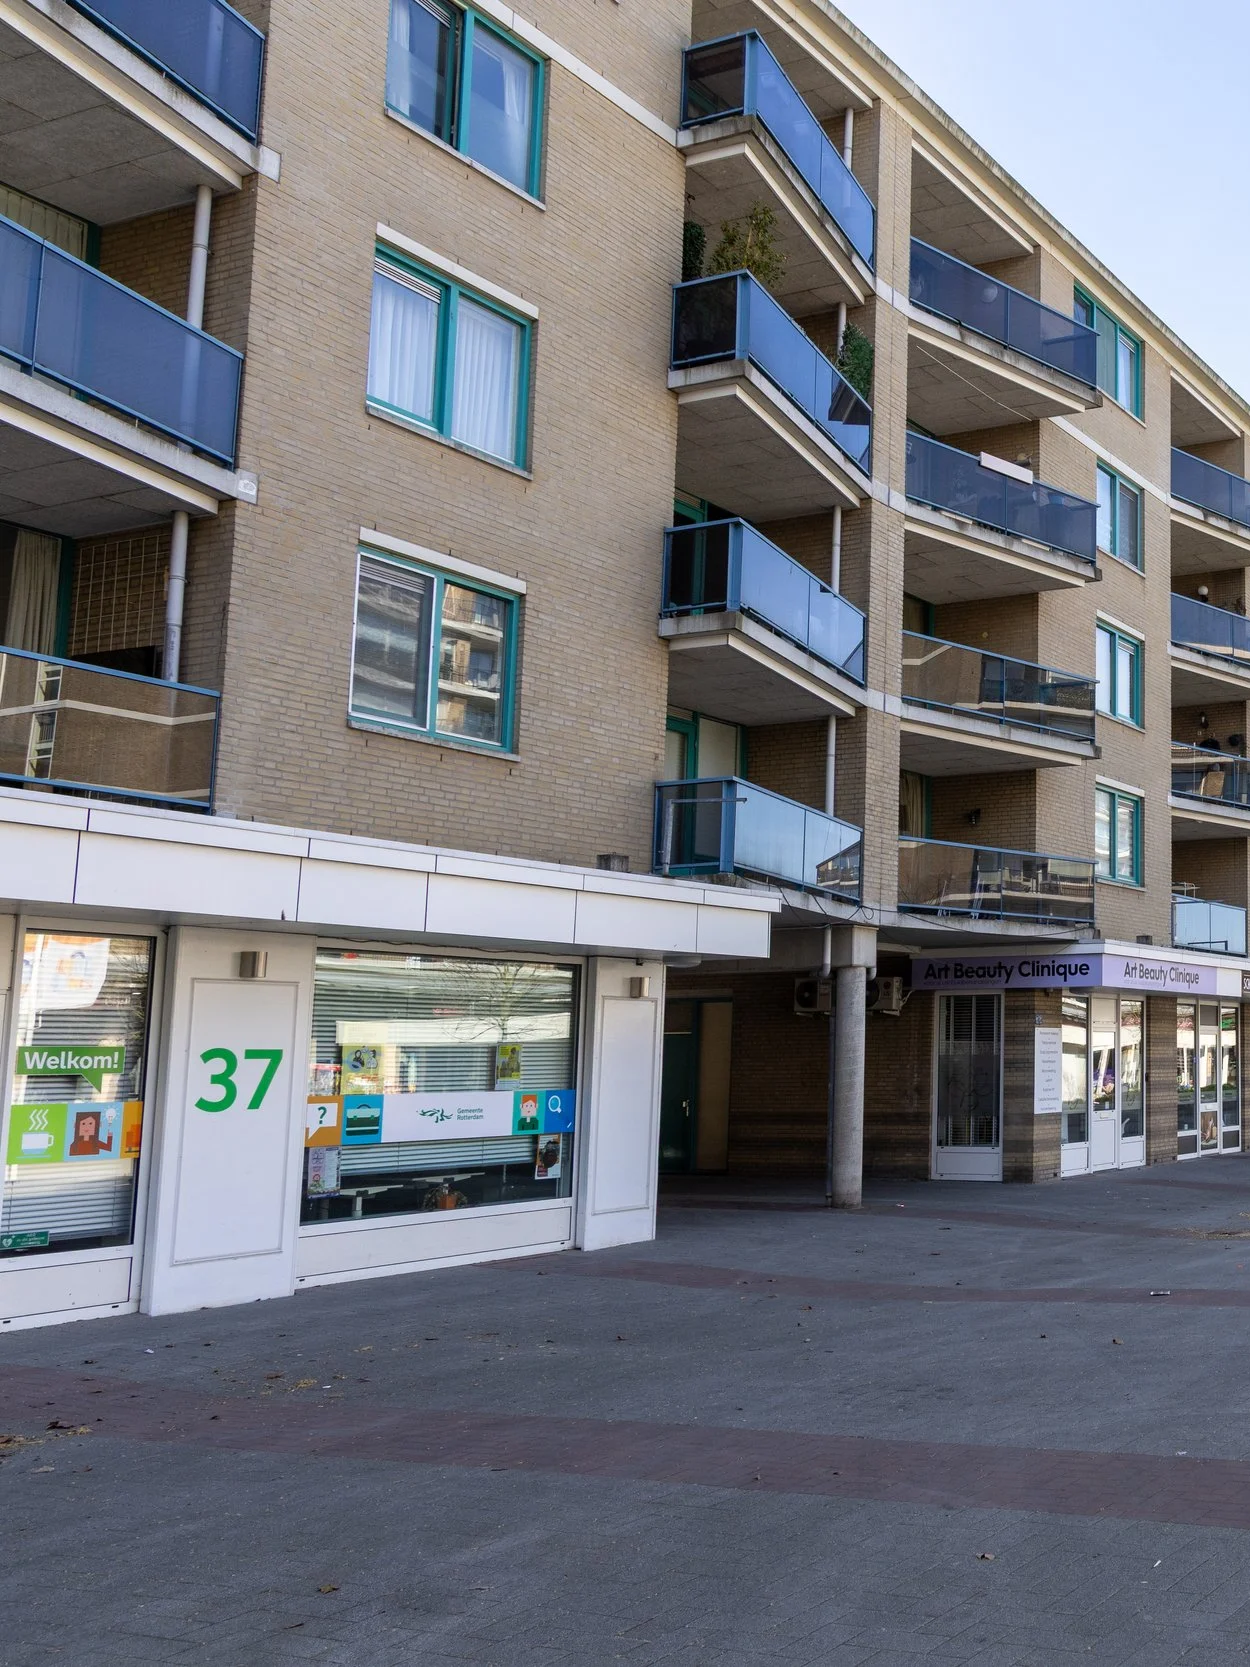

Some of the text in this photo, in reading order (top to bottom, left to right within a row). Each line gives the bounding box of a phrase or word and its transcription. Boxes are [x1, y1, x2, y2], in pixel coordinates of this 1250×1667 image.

[924, 960, 1090, 983] Art Beauty Clinique
[1124, 962, 1199, 989] Art Beauty Clinique
[24, 1051, 119, 1070] Welkom!
[194, 1047, 283, 1113] 37
